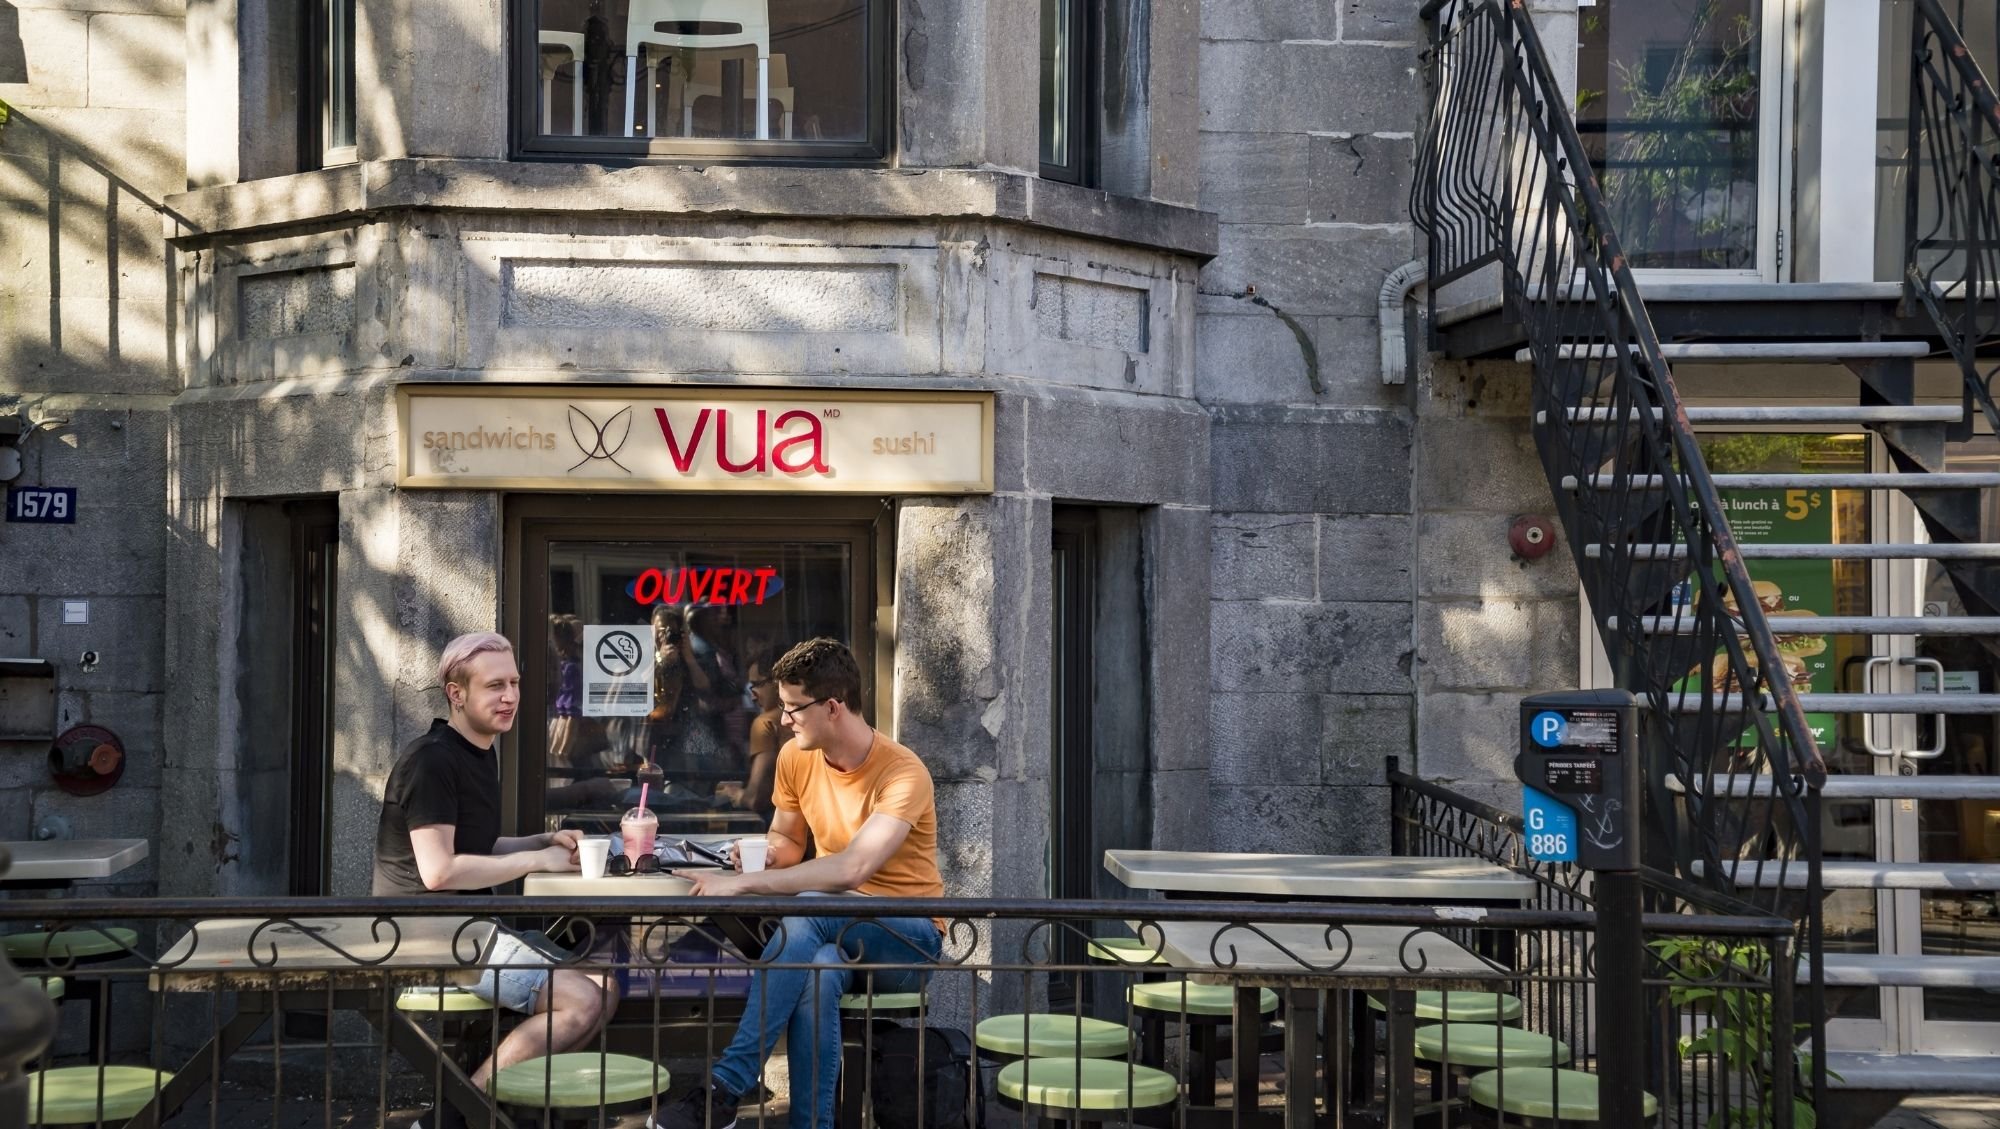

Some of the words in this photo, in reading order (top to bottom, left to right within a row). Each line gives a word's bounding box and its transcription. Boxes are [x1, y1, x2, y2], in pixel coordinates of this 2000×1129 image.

[423, 425, 557, 450] sandwichs
[654, 407, 830, 474] vua
[823, 409, 841, 418] MD
[872, 431, 936, 455] sushi
[17, 491, 67, 518] 1579
[1732, 498, 1768, 510] lunch
[1771, 498, 1780, 510] à
[634, 567, 776, 605] OUVERT
[1529, 808, 1544, 830] G
[1531, 833, 1567, 855] 886
